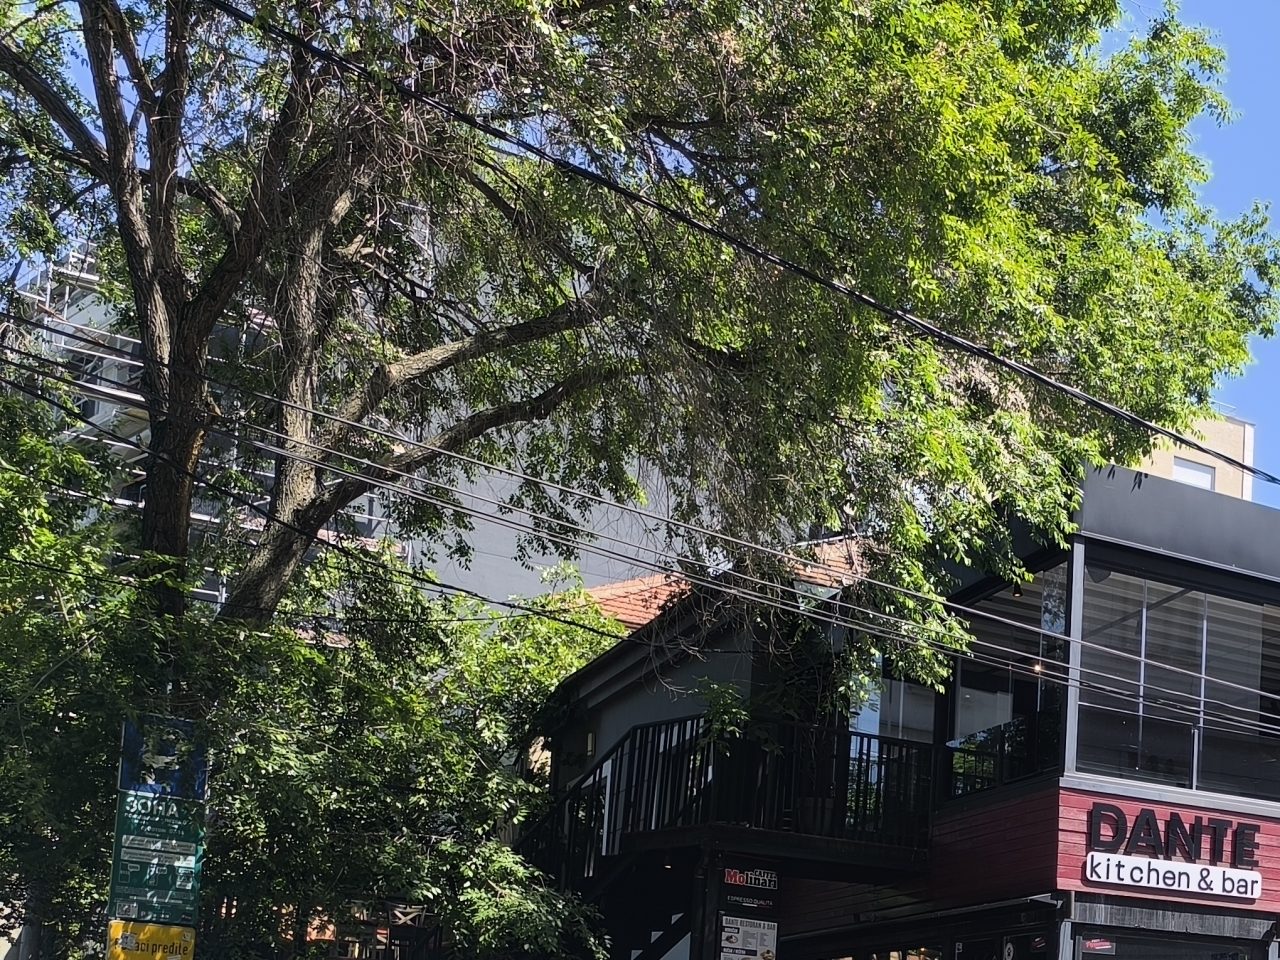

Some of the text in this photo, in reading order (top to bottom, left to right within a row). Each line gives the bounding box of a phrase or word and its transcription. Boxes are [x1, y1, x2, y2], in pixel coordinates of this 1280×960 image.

[1090, 801, 1261, 869] DANTE
[725, 869, 777, 889] Molinari
[1089, 854, 1259, 896] kitchen & bar
